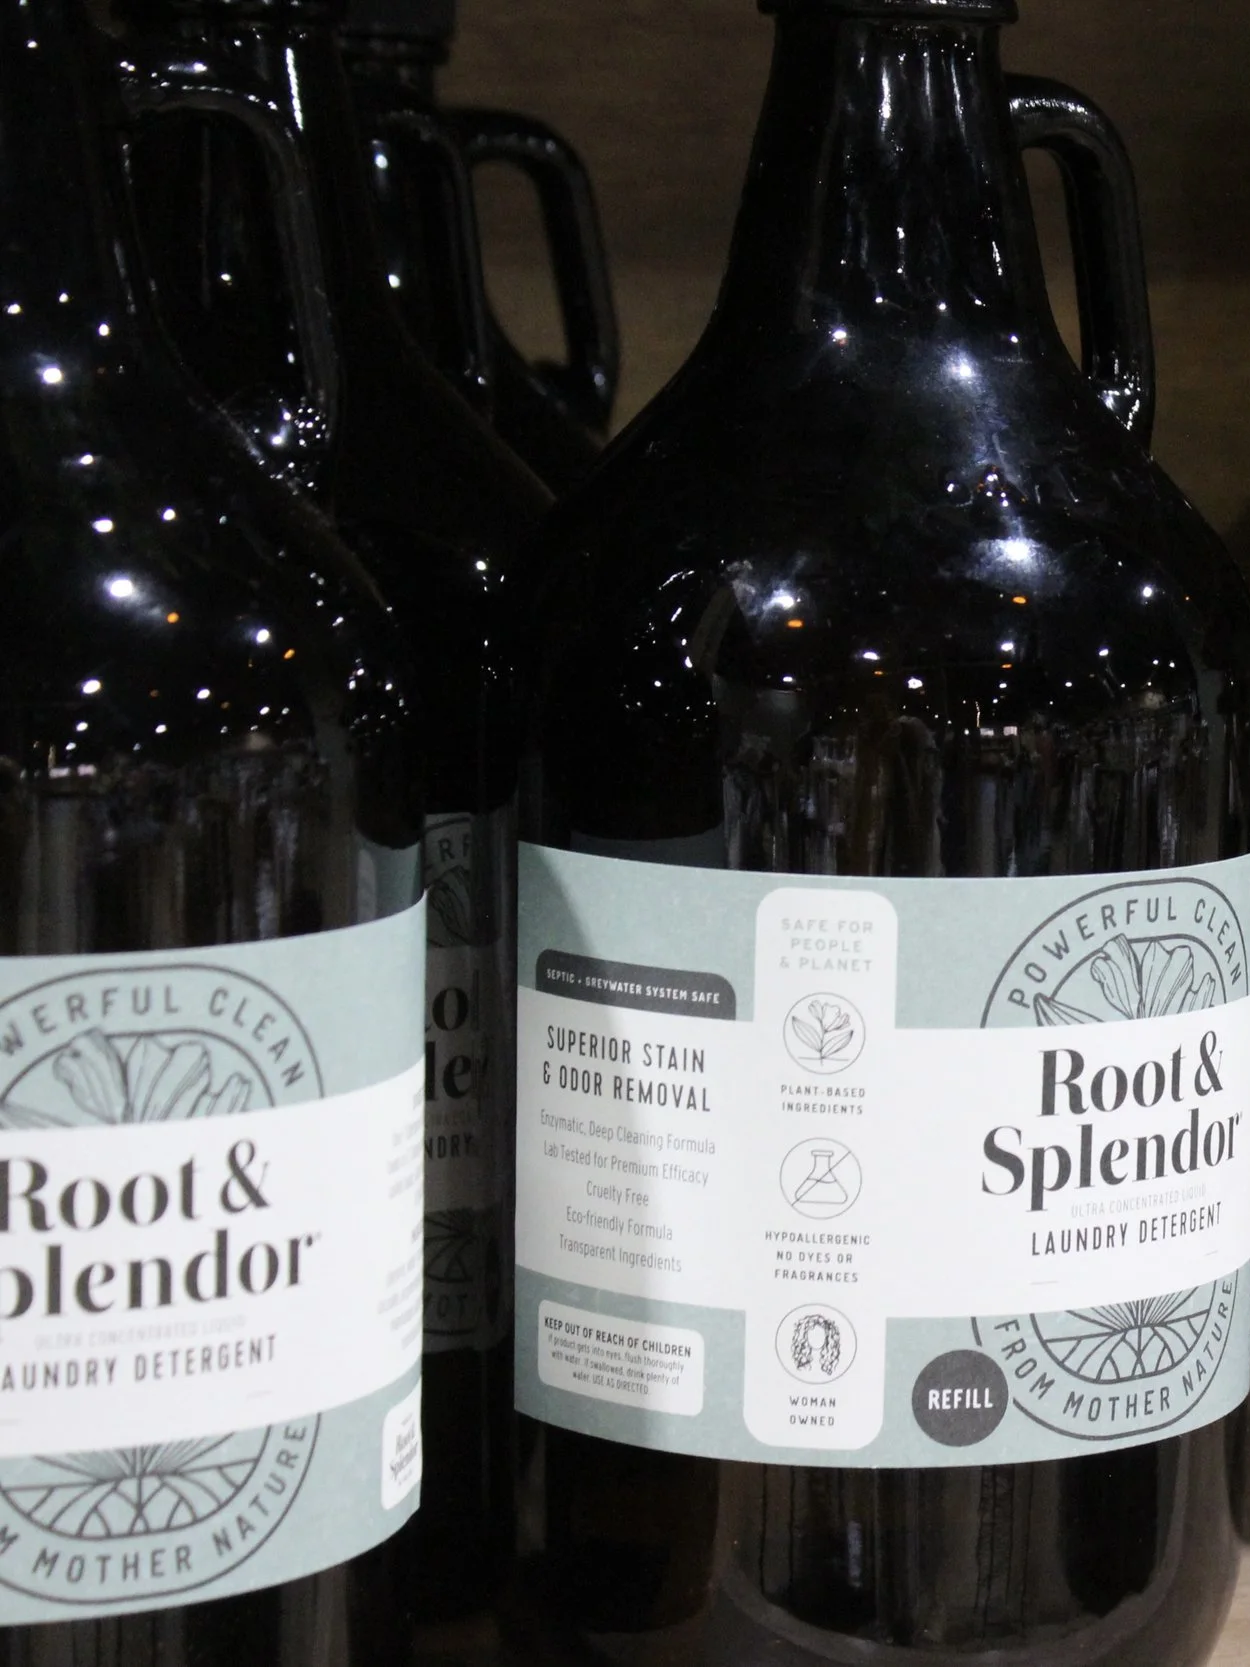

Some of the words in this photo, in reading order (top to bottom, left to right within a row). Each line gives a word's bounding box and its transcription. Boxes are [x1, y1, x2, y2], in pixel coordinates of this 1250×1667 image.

[781, 918, 828, 932] SAFE
[838, 920, 873, 934] FOR
[779, 956, 790, 969] &
[799, 956, 872, 972] PLANET
[791, 938, 862, 953] PEOPLE
[1007, 895, 1177, 1010] POWERFUL
[1194, 898, 1242, 987] CLEAN
[546, 968, 575, 984] SEPTIC
[585, 976, 642, 995] GREYWATER
[645, 985, 687, 1001] SYSTEM
[691, 991, 720, 1004] SAFE
[0, 986, 181, 1056] WERFUL
[209, 987, 305, 1088] CLEAN
[547, 1025, 631, 1065] SUPERIOR
[643, 1043, 705, 1074] STAIN
[543, 1061, 551, 1085] &
[559, 1065, 603, 1097] ODOR
[613, 1075, 711, 1112] REMOVAL
[780, 1084, 866, 1098] PLANT-BASED
[1036, 1043, 1186, 1118] Root
[1194, 1030, 1224, 1097] &
[782, 1101, 863, 1115] INGREDIENTS
[540, 1108, 587, 1136] Enzymatic,
[589, 1120, 613, 1142] Deep
[616, 1125, 664, 1151] Cleaning
[667, 1133, 716, 1155] Formula
[544, 1140, 559, 1158] Lab
[560, 1144, 591, 1166] Tested
[594, 1152, 608, 1169] for
[611, 1155, 659, 1178] Premium
[662, 1163, 709, 1188] Efficacy
[981, 1107, 1240, 1213] Splendor
[0, 1153, 201, 1234] Root
[219, 1138, 271, 1216] &
[586, 1180, 623, 1205] Cruelty
[625, 1187, 649, 1207] Free
[1071, 1202, 1105, 1219] ULTRA
[1109, 1189, 1179, 1214] CONCENTRATED
[1182, 1183, 1207, 1202] LIQUID
[566, 1205, 625, 1236] Eco-friendly
[627, 1218, 673, 1241] Formula
[765, 1231, 870, 1246] HYPOALLERGENIC
[1031, 1222, 1128, 1256] LAUNDRY
[1139, 1201, 1221, 1244] DETERGENT
[559, 1233, 616, 1262] Transparent
[619, 1247, 682, 1273] Ingredients
[776, 1250, 792, 1261] NO
[799, 1251, 831, 1264] DYES
[837, 1253, 853, 1264] OR
[774, 1268, 858, 1283] FRAGRANCES
[544, 1316, 563, 1331] KEEP
[565, 1322, 580, 1336] OUT
[583, 1327, 593, 1339] OF
[596, 1330, 624, 1347] REACH
[627, 1336, 640, 1349] OF
[642, 1339, 691, 1358] CHILDREN
[994, 1318, 1056, 1401] FROM
[1062, 1386, 1170, 1422] MOTHER
[1181, 1279, 1233, 1397] NATURE
[1, 1357, 117, 1392] AUNDRY
[134, 1333, 277, 1383] DETERGENT
[789, 1395, 837, 1409] WOMAN
[928, 1388, 994, 1410] REFILL
[789, 1414, 835, 1426] OWNED
[31, 1544, 192, 1585] MOTHER
[211, 1424, 307, 1557] NATURE
